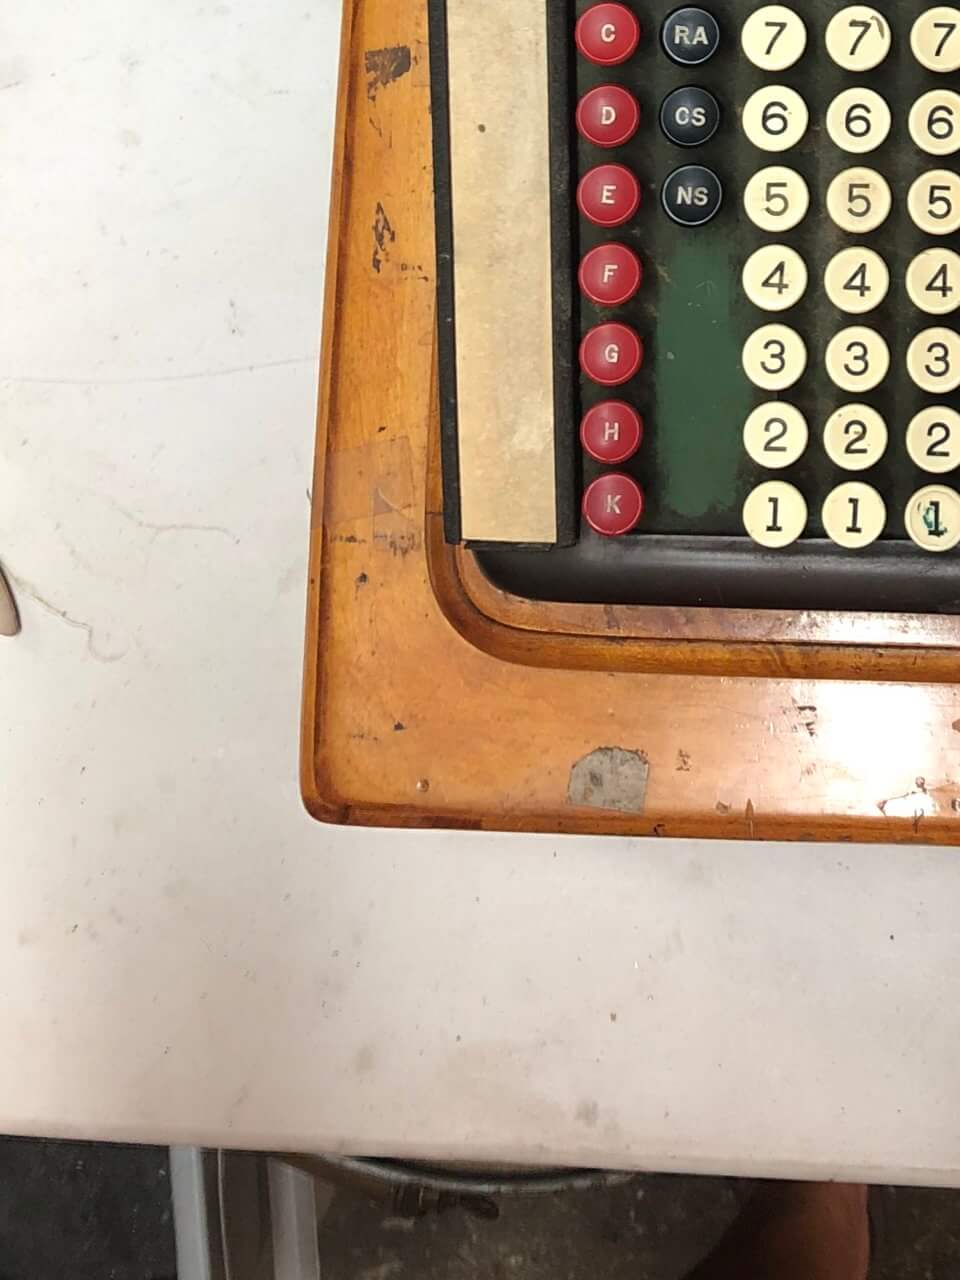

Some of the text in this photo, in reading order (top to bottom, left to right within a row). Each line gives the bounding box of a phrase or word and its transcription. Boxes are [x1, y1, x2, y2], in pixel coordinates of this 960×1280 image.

[601, 24, 616, 43] C
[674, 26, 708, 45] RA
[766, 22, 786, 54] 7
[850, 20, 871, 55] 7
[934, 23, 955, 56] 7
[601, 106, 616, 125] D
[762, 102, 787, 135] 6
[846, 104, 870, 137] 6
[928, 106, 953, 139] 6
[601, 186, 616, 204] E
[677, 187, 708, 206] NS
[766, 183, 788, 216] 5
[848, 184, 870, 217] 5
[928, 185, 951, 219] 5
[602, 264, 618, 283] F
[762, 262, 788, 293] 4
[843, 263, 870, 296] 4
[926, 264, 952, 297] 4
[604, 344, 619, 363] G
[761, 340, 784, 373] 3
[845, 342, 868, 376] 3
[925, 343, 949, 377] 3
[604, 422, 619, 441] H
[764, 418, 786, 451] 2
[845, 420, 867, 454] 2
[927, 423, 950, 456] 2
[606, 494, 622, 514] K
[767, 498, 781, 531] 1
[846, 498, 861, 533] 1
[928, 500, 945, 535] 1
